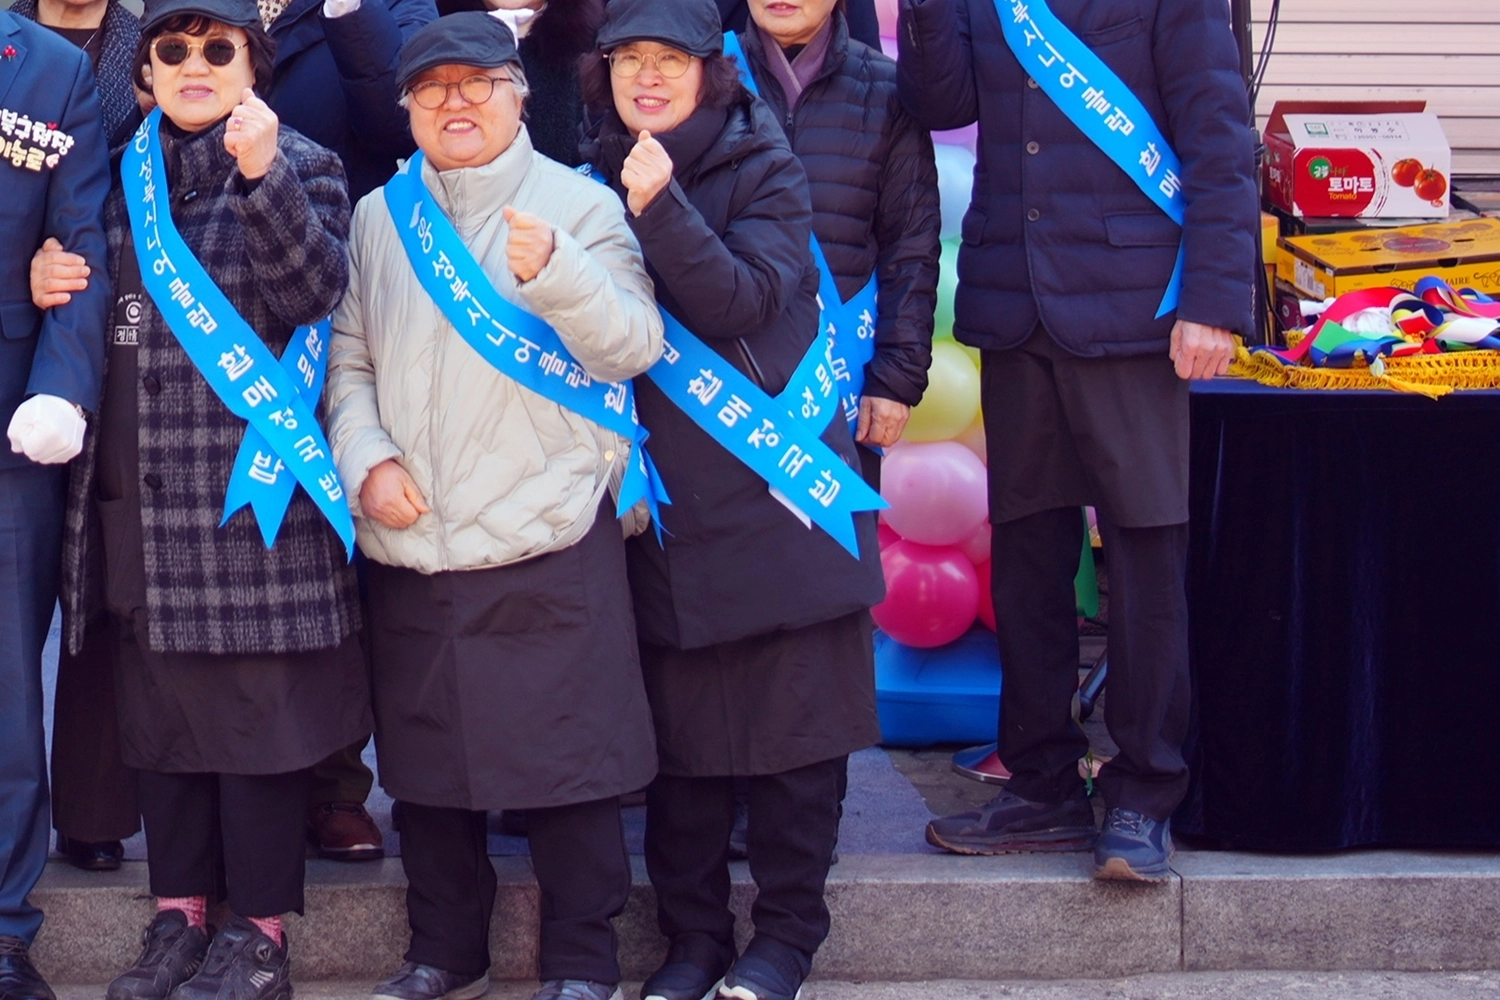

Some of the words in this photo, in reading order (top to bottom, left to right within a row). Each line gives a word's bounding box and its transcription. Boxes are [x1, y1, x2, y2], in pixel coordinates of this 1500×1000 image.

[1328, 176, 1374, 195] 토마토
[1329, 192, 1358, 200] Tomato
[139, 157, 218, 336] 성북시니어클럽
